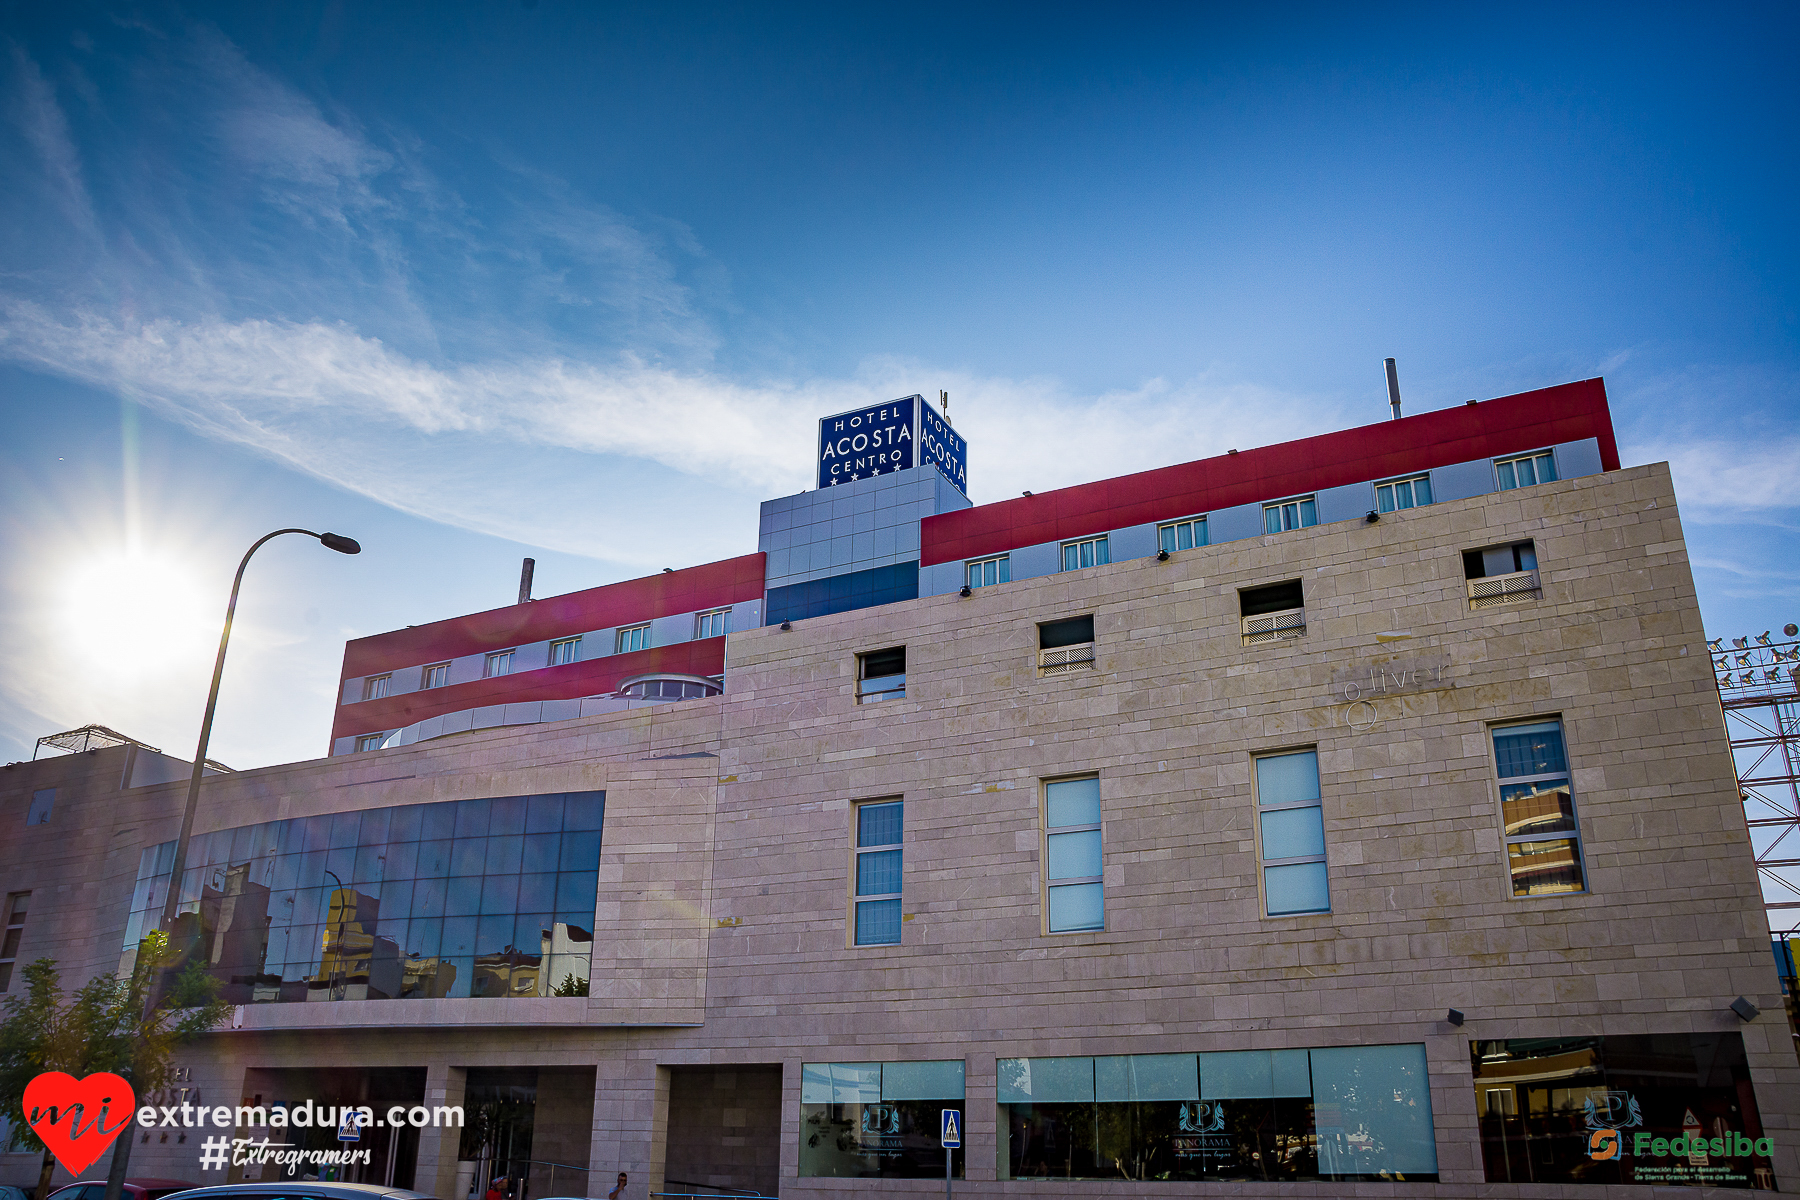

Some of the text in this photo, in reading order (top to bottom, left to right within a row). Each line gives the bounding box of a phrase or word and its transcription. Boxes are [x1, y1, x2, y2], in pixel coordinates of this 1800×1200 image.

[834, 407, 900, 432] HOTEL
[927, 411, 960, 452] HOTEL
[822, 423, 911, 461] ACOSTA
[921, 428, 966, 484] ACOSTA
[830, 449, 902, 475] CENTRO
